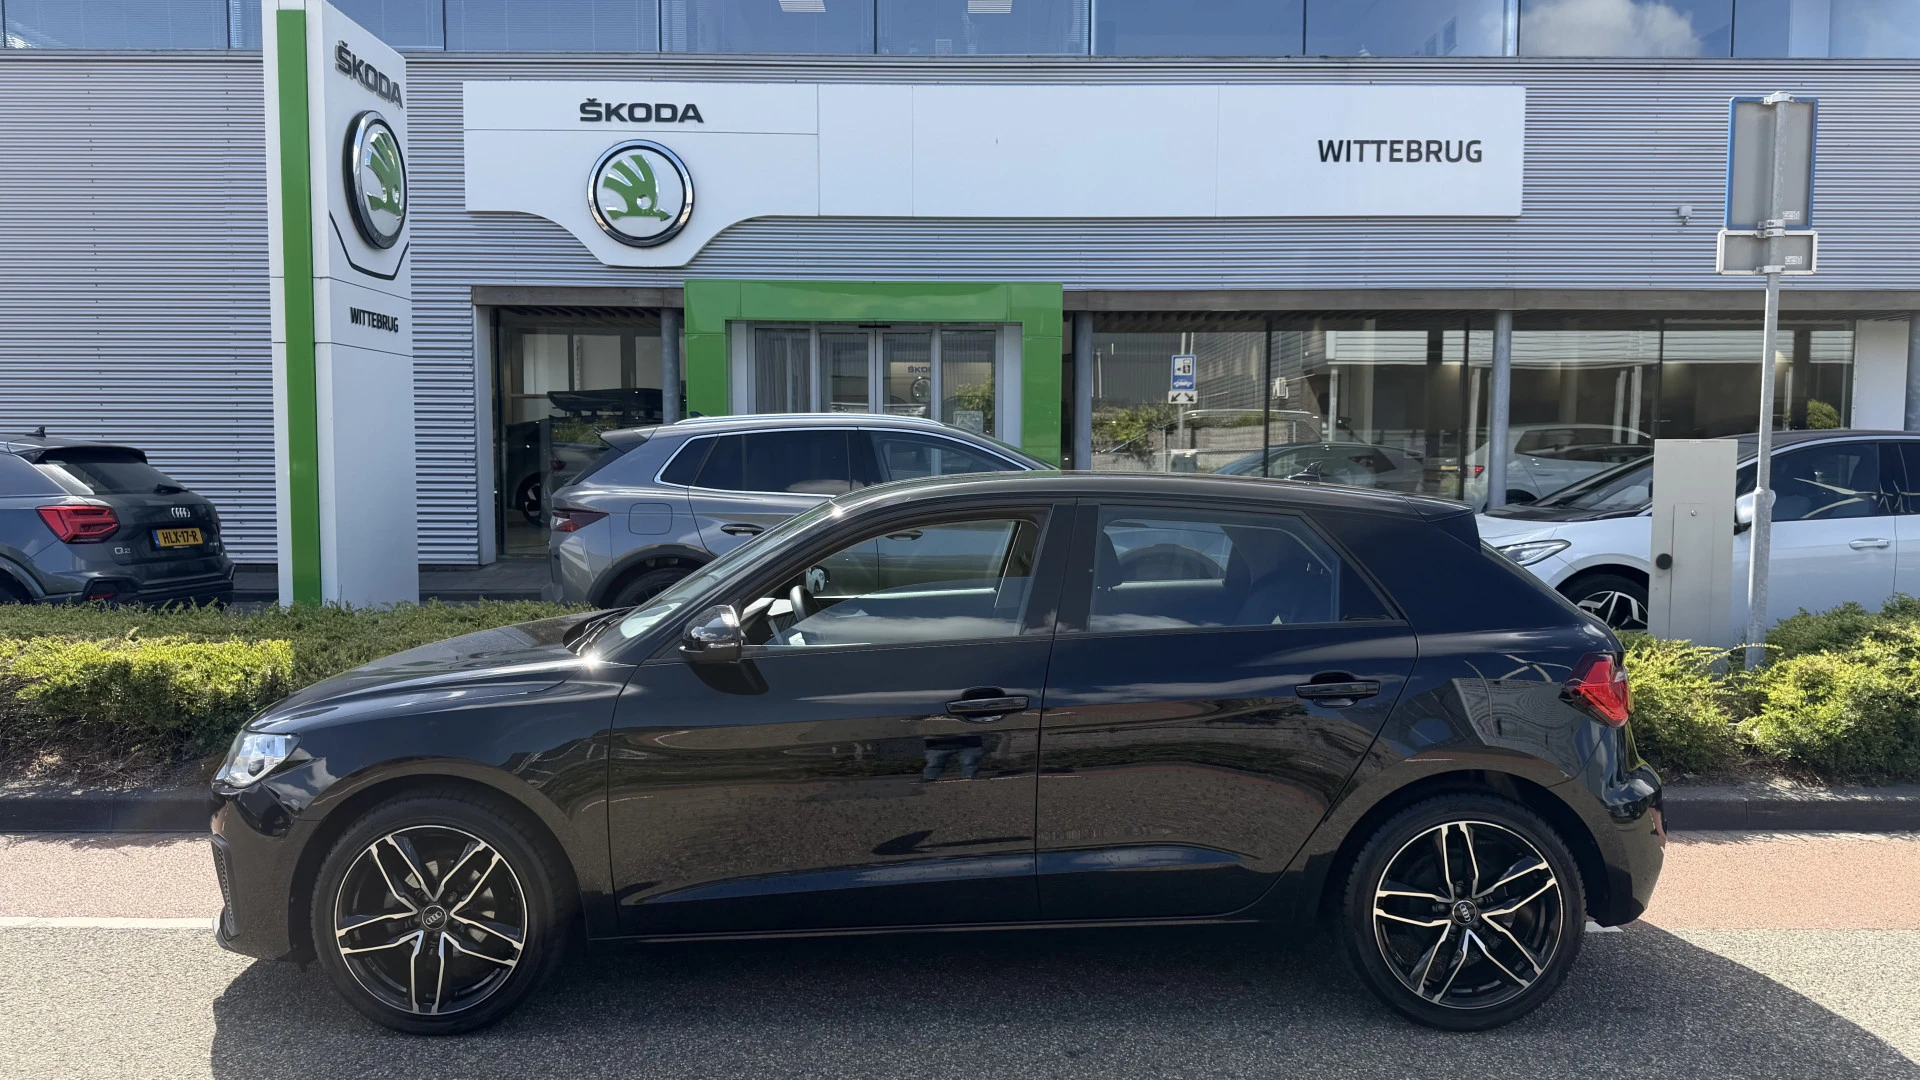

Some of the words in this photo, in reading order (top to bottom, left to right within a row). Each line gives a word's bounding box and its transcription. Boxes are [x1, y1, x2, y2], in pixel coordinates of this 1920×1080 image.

[335, 39, 403, 110] ŠKODA
[579, 98, 704, 123] ŠKODA
[1318, 139, 1482, 163] WITTEBRUG
[349, 306, 399, 333] WITTEBRUG
[162, 530, 199, 544] HLX-17-R
